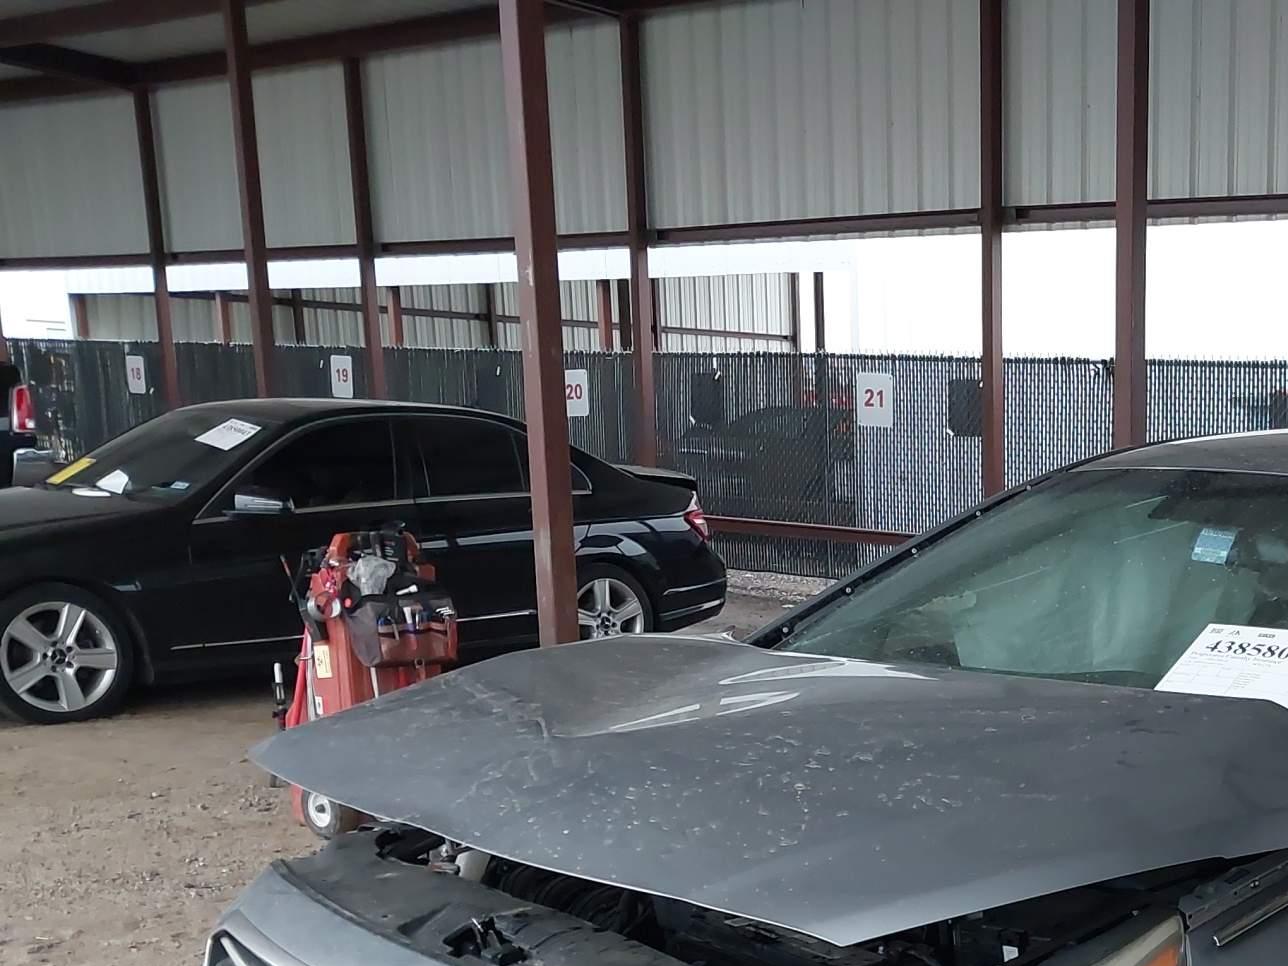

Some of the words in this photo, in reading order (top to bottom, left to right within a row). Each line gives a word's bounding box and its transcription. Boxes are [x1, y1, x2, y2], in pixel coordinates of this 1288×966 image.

[336, 368, 348, 383] 19
[566, 383, 583, 400] 20
[864, 388, 884, 408] 21
